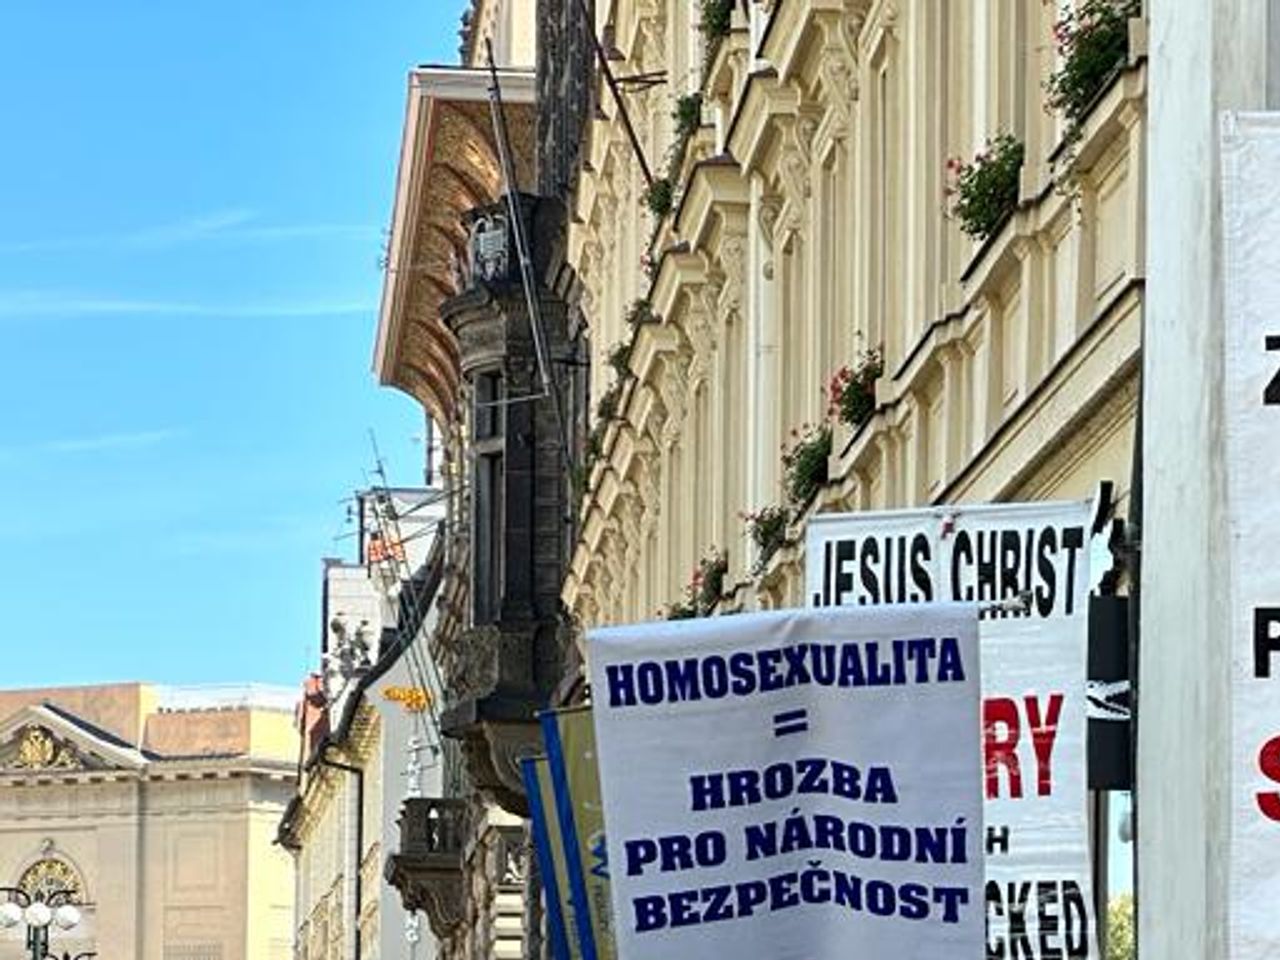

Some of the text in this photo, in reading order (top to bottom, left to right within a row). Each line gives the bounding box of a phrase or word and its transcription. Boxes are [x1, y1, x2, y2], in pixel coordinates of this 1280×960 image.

[813, 525, 1084, 620] JESUS CHRIST
[605, 637, 966, 708] HOMOSEXUALITA
[772, 708, 809, 739] =
[689, 758, 899, 812] HROZBA
[624, 806, 969, 877] PRO NÁRODNÍ
[632, 860, 970, 934] BEZPEČNOST
